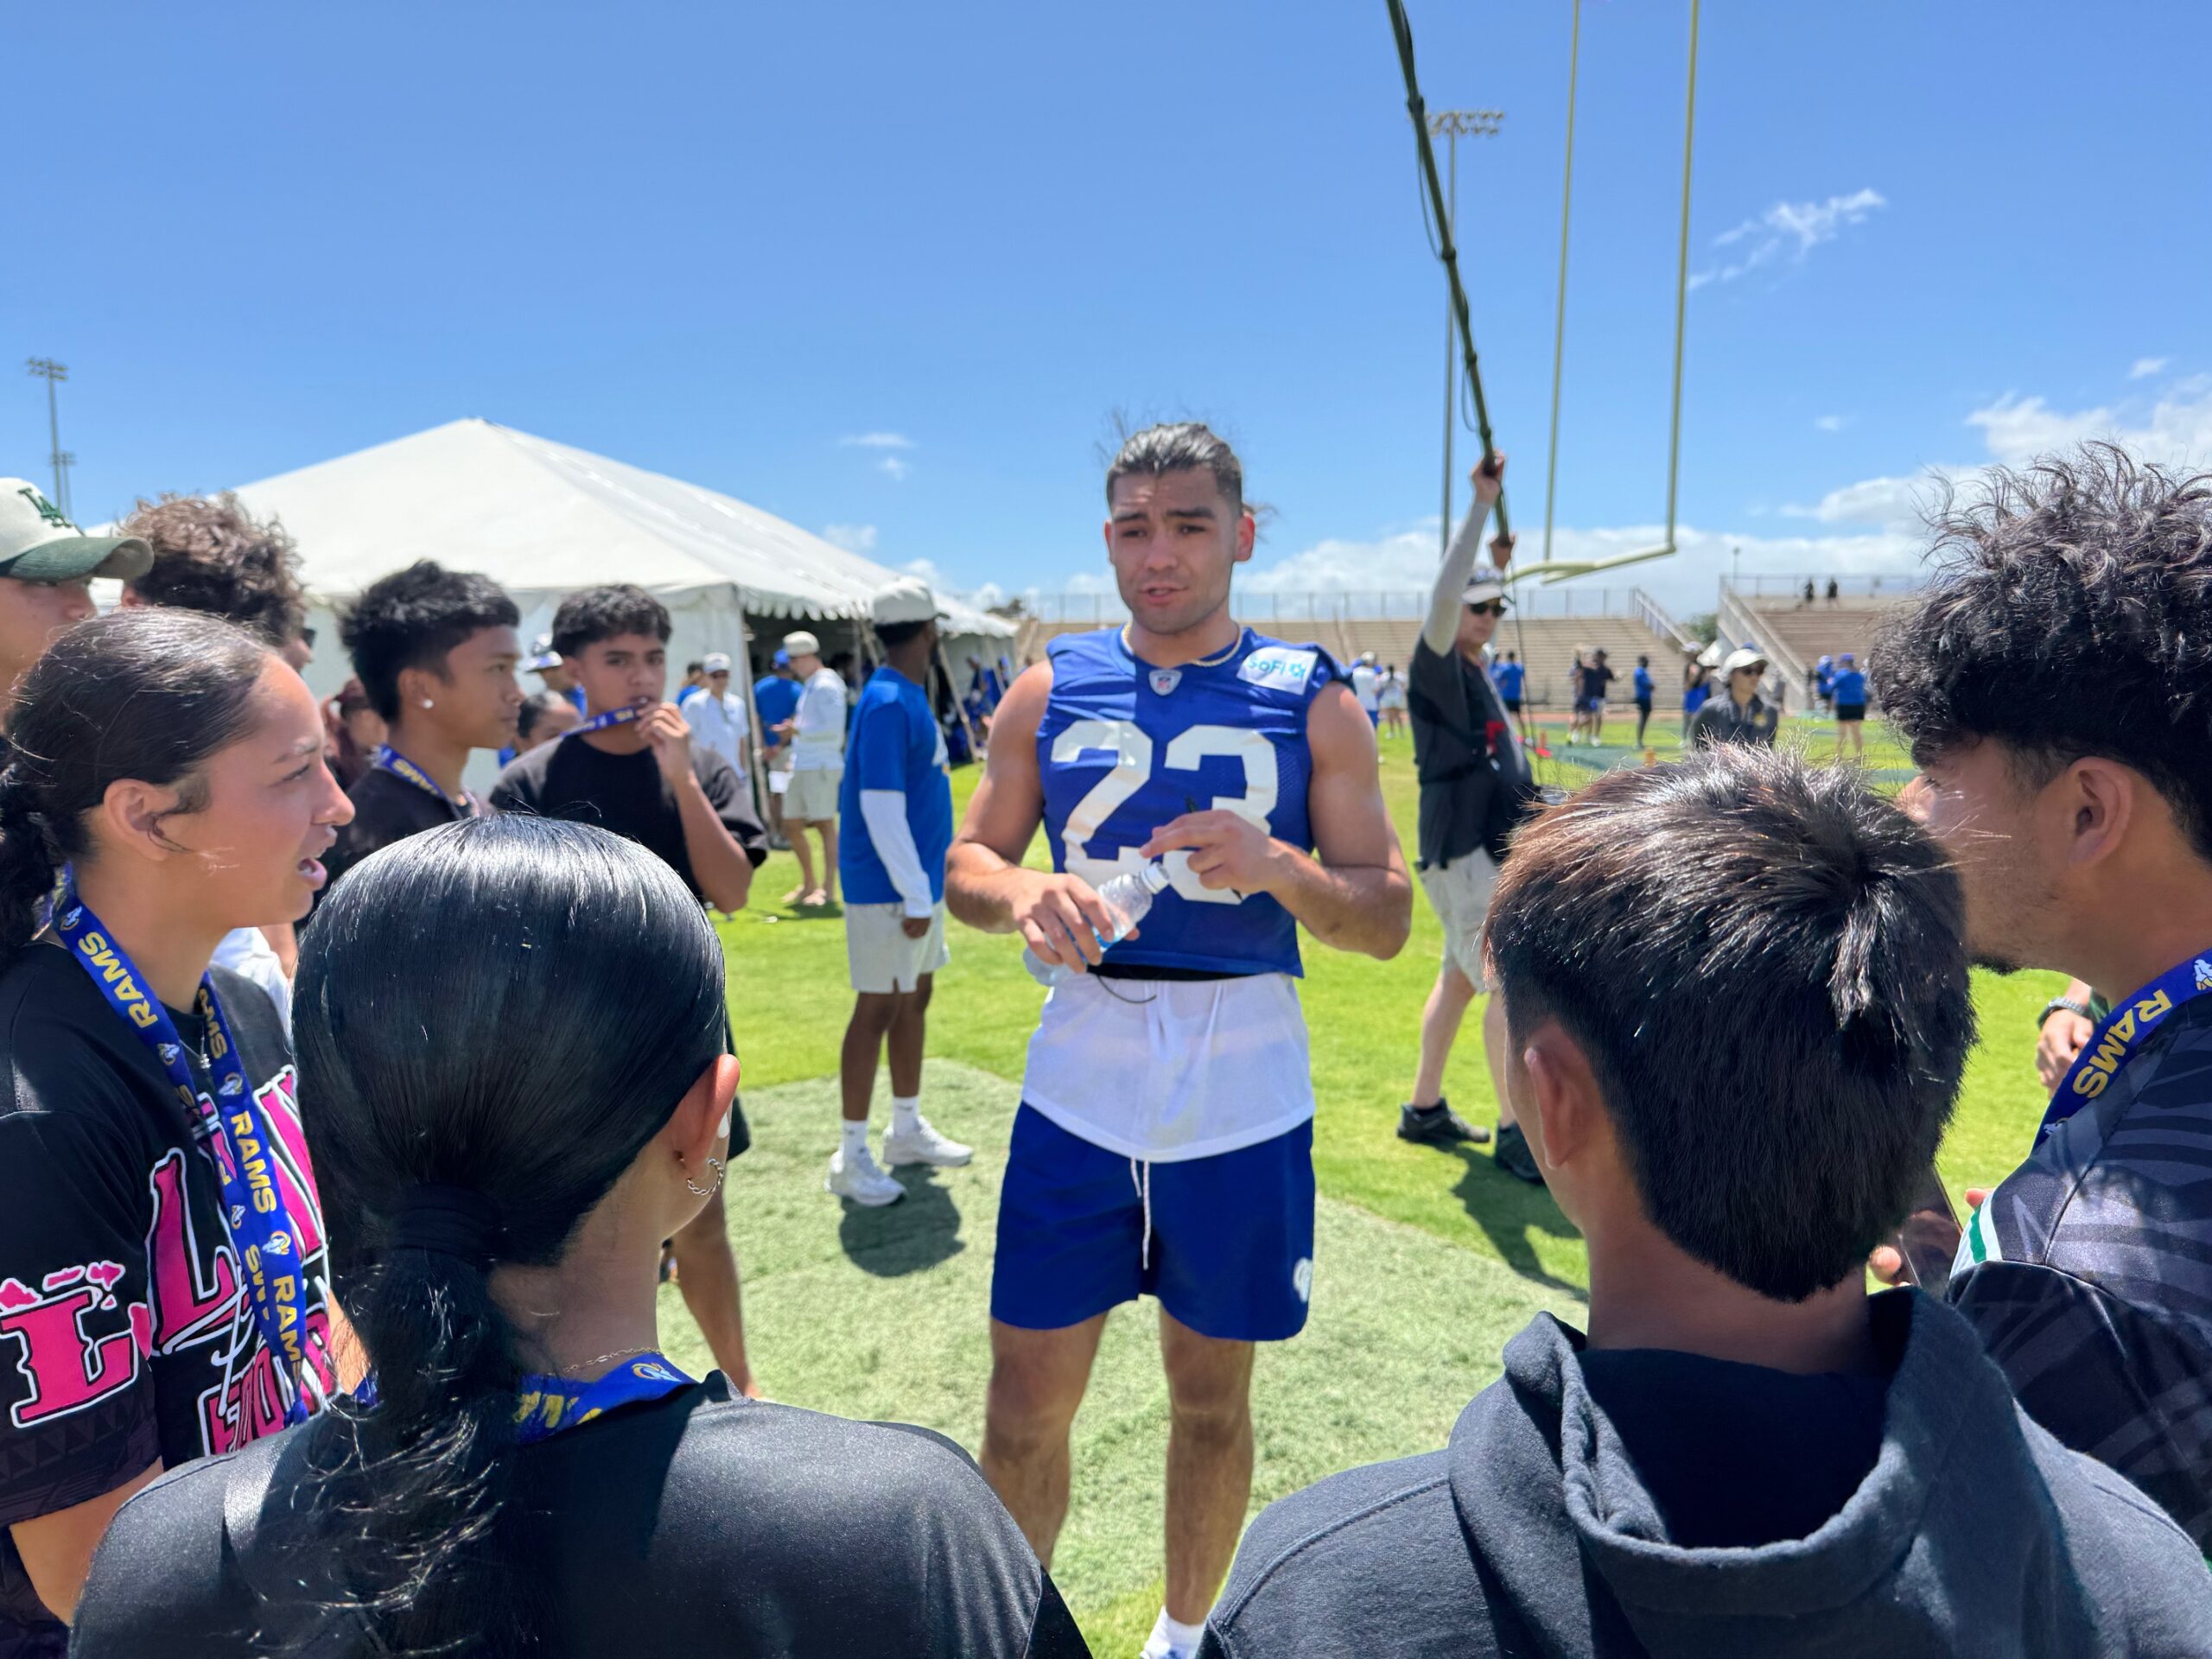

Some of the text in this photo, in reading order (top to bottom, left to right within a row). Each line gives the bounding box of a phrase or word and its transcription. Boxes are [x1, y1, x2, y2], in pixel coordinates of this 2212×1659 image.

[1051, 720, 1278, 906] 23
[79, 931, 159, 1028] RAMS
[2073, 988, 2173, 1098] RAMS
[230, 1109, 277, 1213] RAMS
